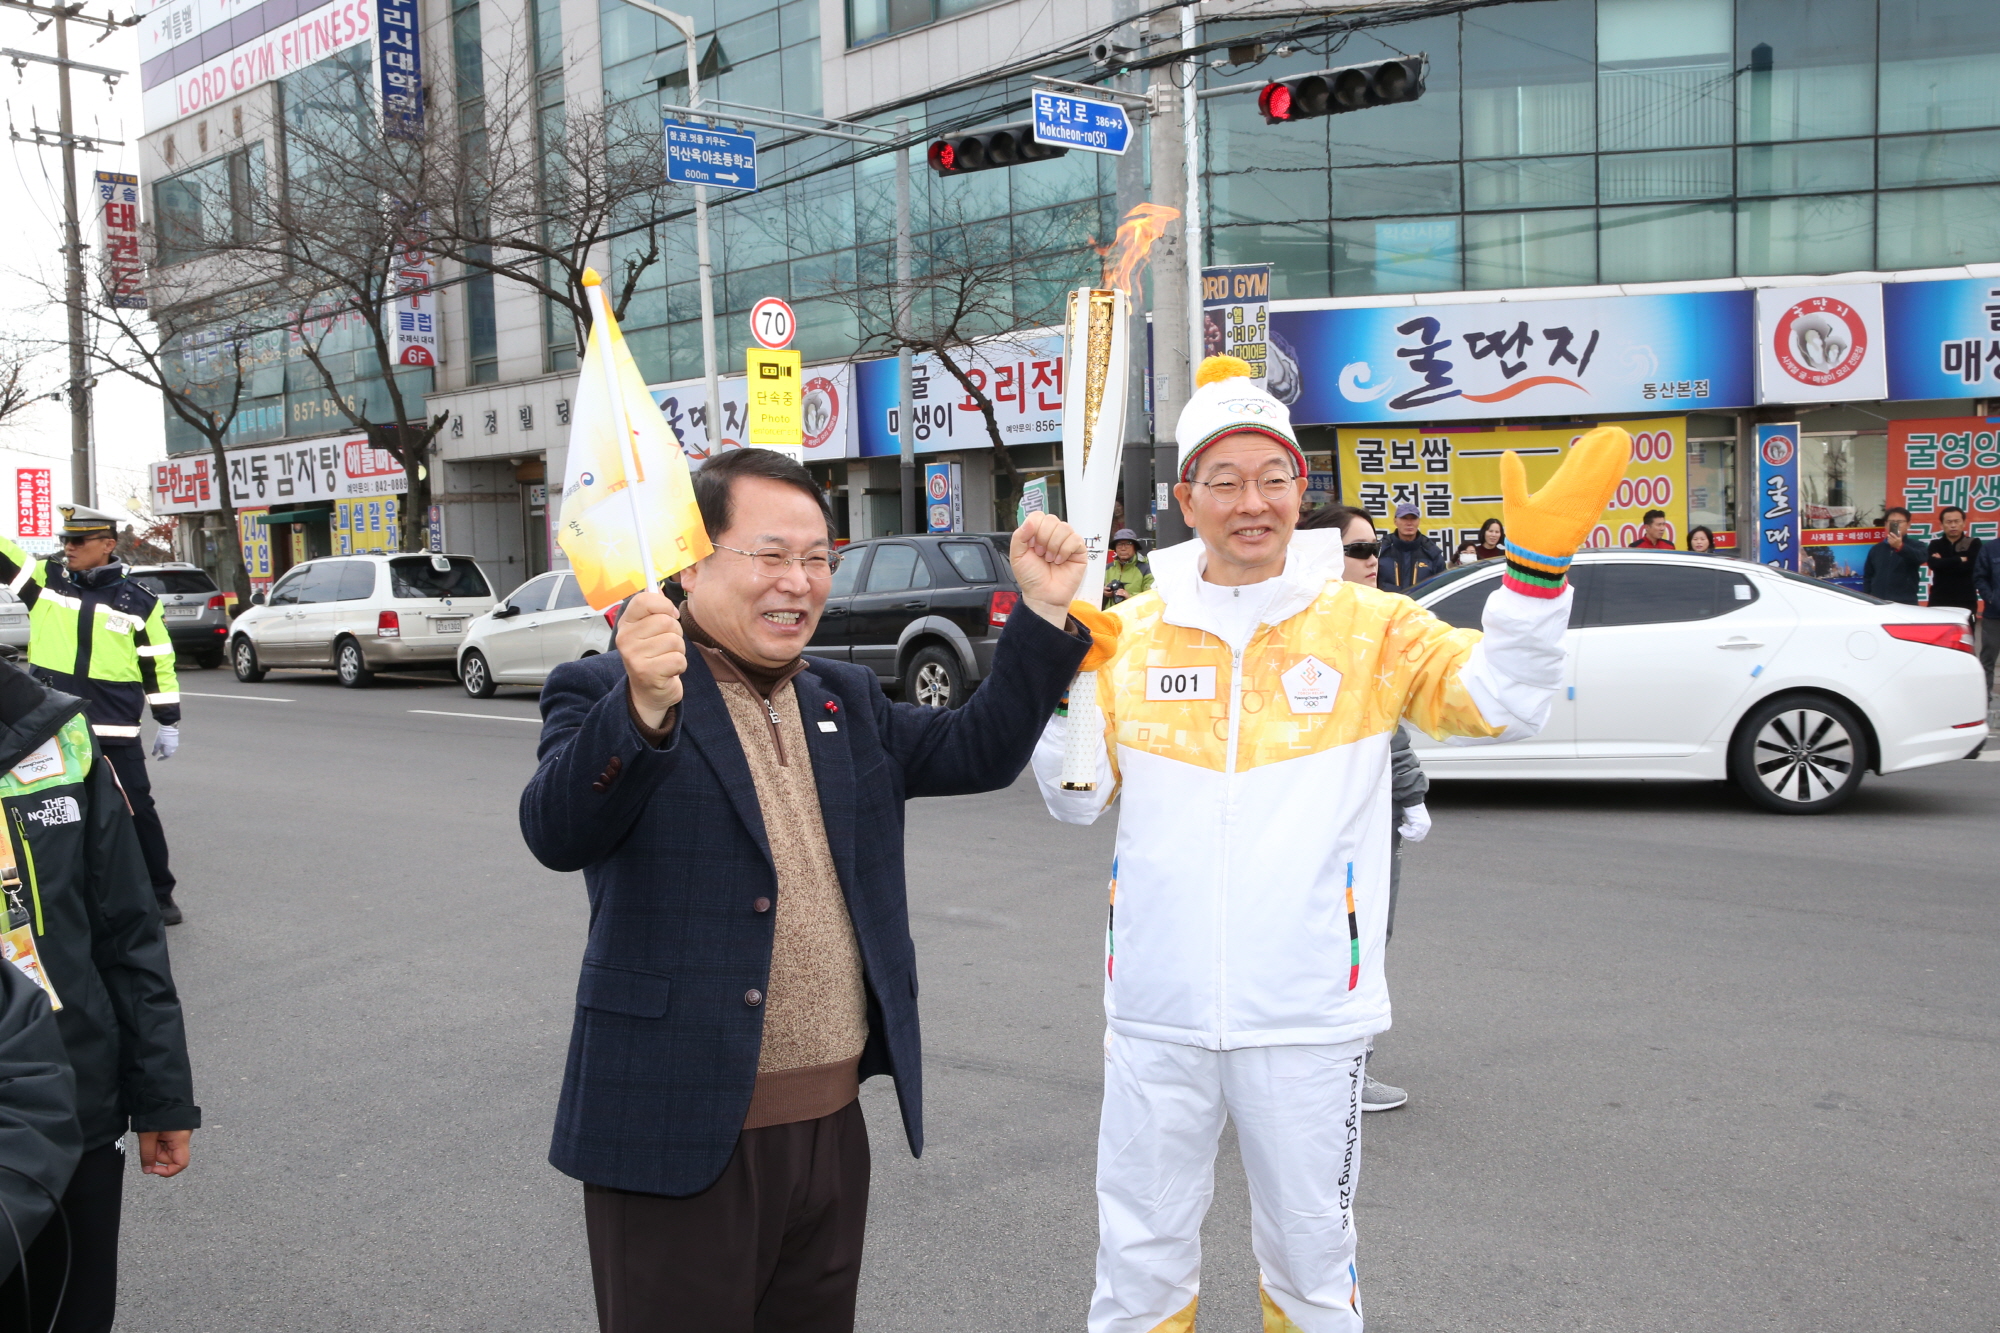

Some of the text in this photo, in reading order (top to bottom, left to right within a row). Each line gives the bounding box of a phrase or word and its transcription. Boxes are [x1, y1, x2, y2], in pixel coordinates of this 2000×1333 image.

[178, 0, 370, 116] LORD GYM FITNESS
[1039, 97, 1088, 124] 목천로
[1039, 122, 1107, 148] Mokcheon-ro(St)
[685, 169, 709, 180] 600m
[104, 202, 146, 296] 태권도
[1233, 273, 1268, 299] GYM
[400, 312, 432, 332] 클럽
[762, 311, 787, 336] 70
[408, 349, 426, 364] 6F
[1388, 315, 1600, 410] 굴딴지
[756, 391, 793, 406] 단속중
[1641, 380, 1710, 400] 동산본점
[293, 395, 355, 421] 857-956
[761, 413, 791, 424] Photo
[1356, 438, 1452, 474] 굴보쌈
[156, 459, 211, 508] 무한리필
[384, 500, 397, 555] 우거
[1160, 674, 1198, 693] 001
[27, 806, 67, 822] NORTH
[41, 797, 66, 809] THE
[42, 814, 69, 827] FACE
[1337, 1054, 1364, 1187] PyeongChang
